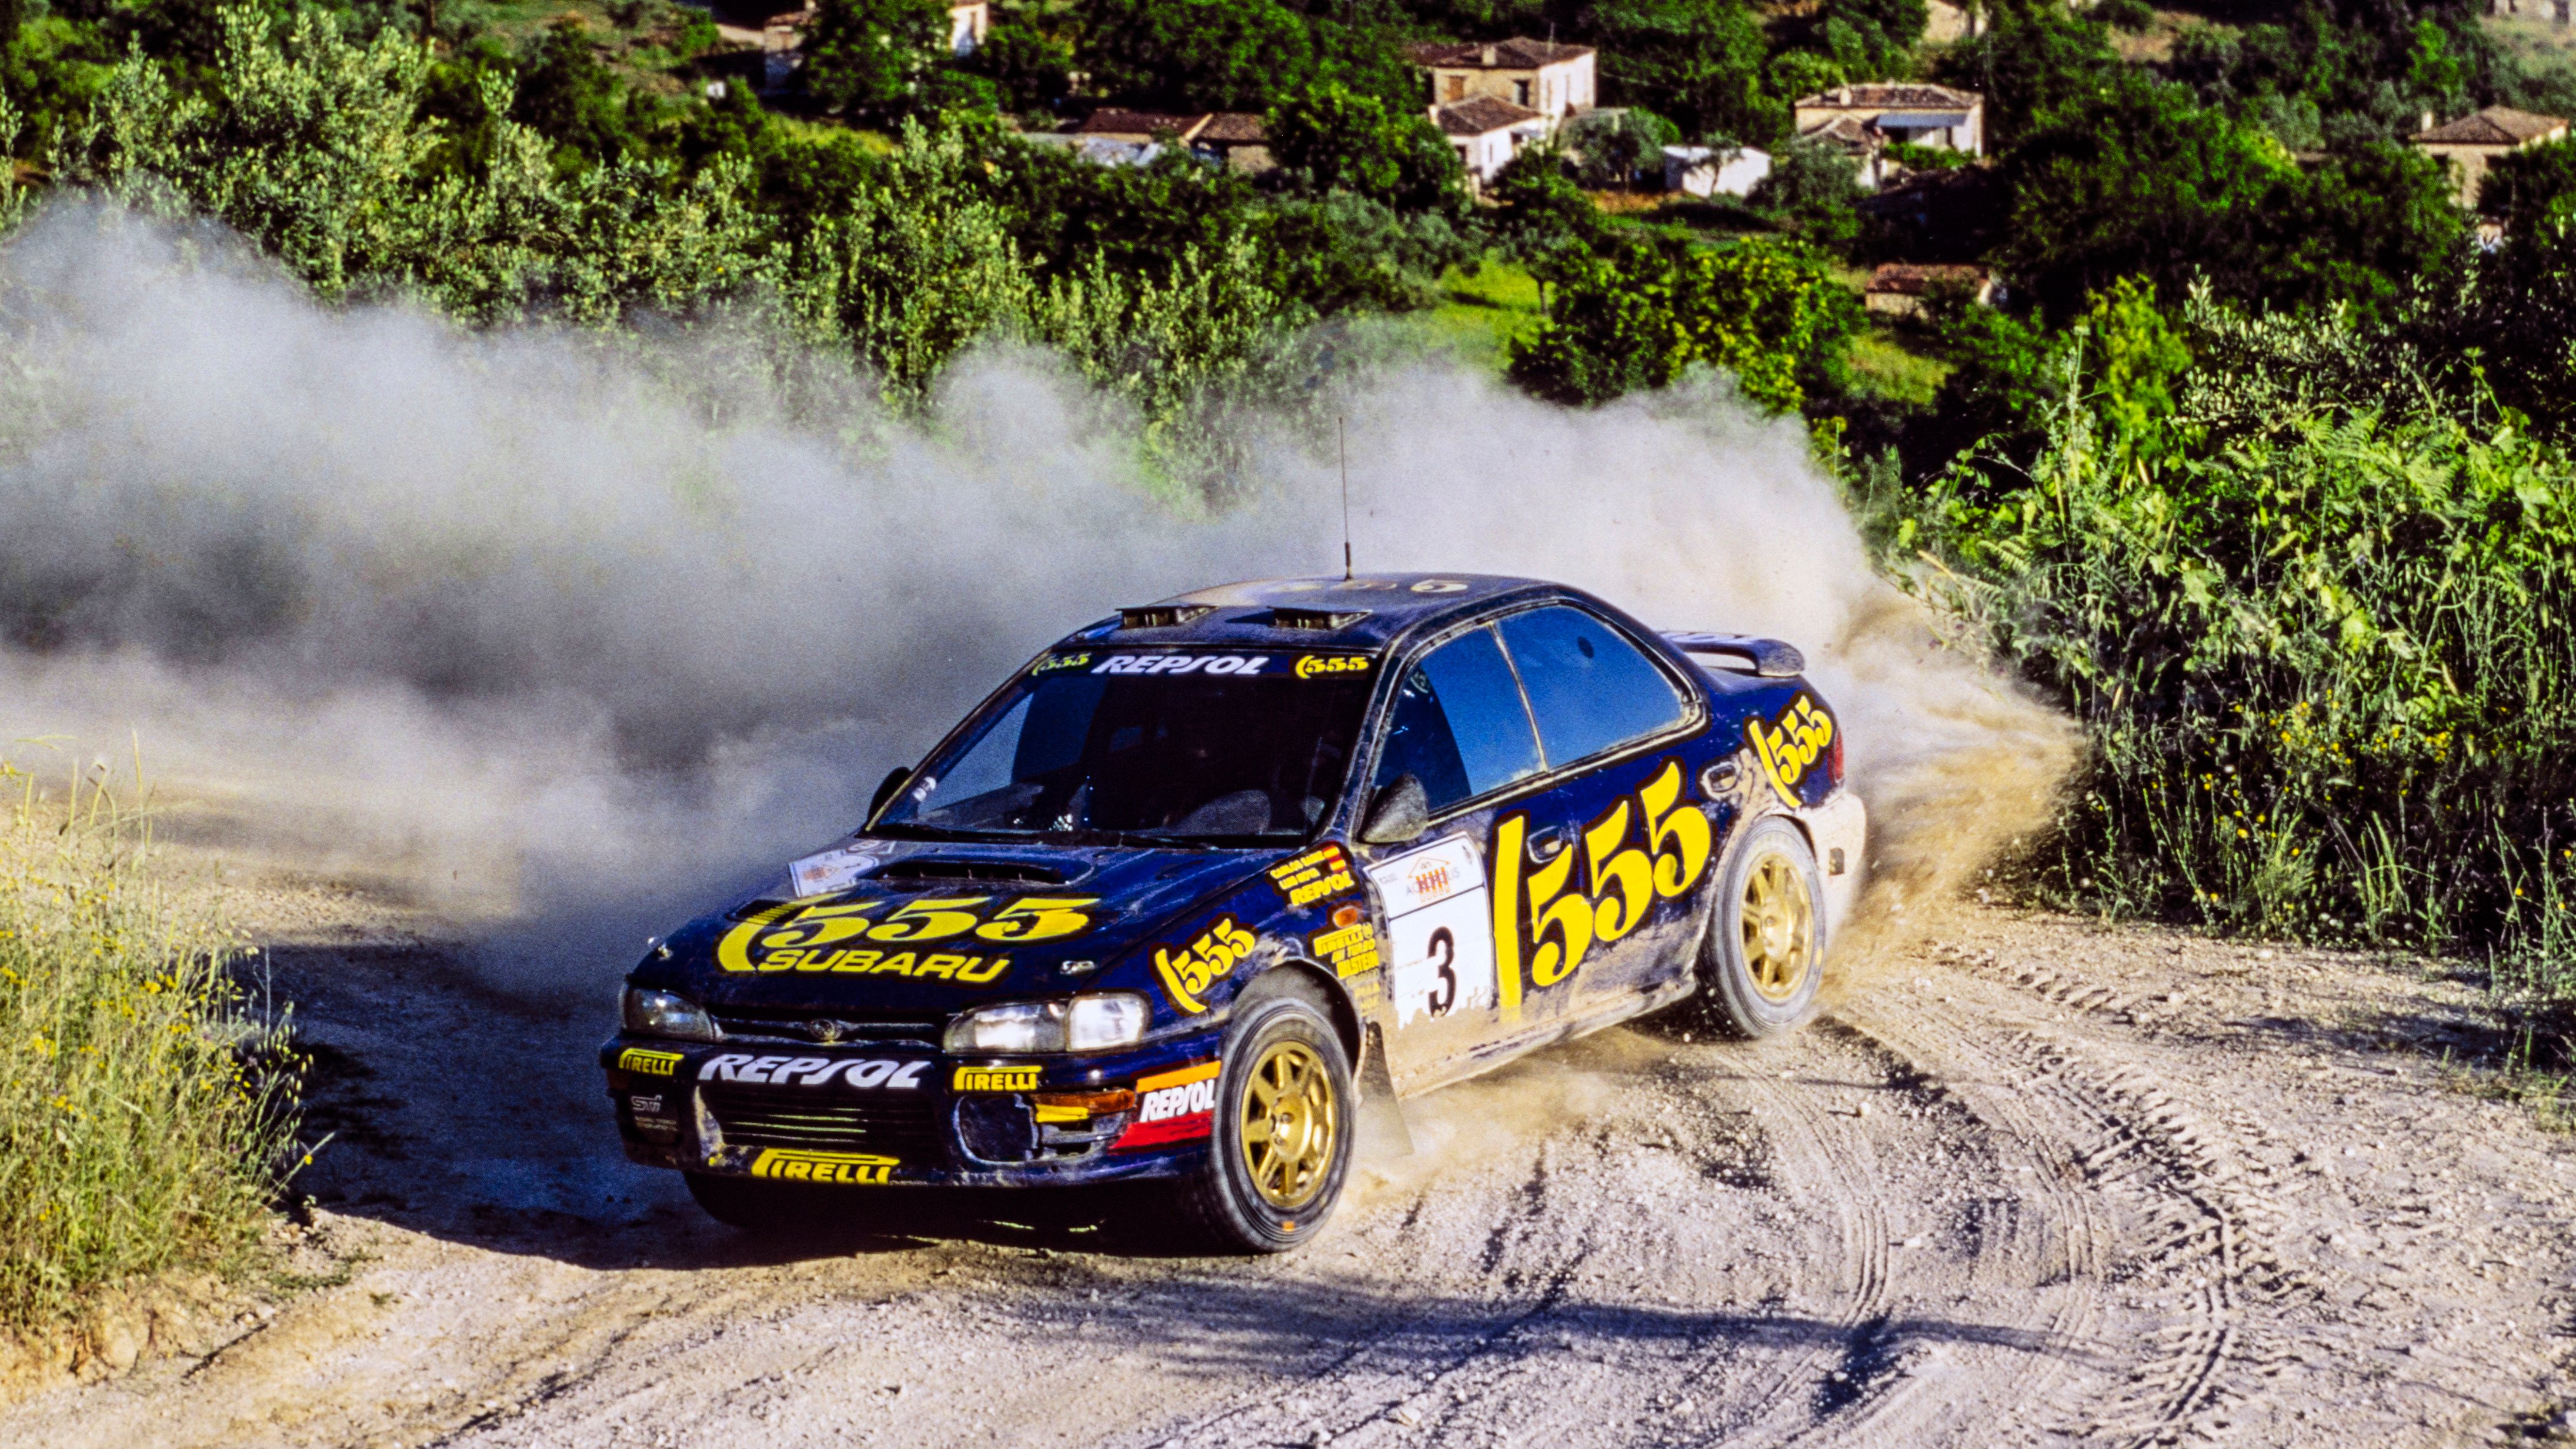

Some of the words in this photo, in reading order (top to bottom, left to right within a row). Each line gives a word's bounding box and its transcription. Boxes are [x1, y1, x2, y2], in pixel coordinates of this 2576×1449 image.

[1039, 652, 1092, 671] 555
[1091, 655, 1269, 675] REPSOL
[1307, 655, 1369, 674] 555
[1766, 695, 1833, 785] 555
[1290, 870, 1354, 906] REPSOL
[1527, 762, 1711, 987] 555
[762, 896, 1100, 949] 555
[757, 949, 1009, 983] SUBARU
[1171, 918, 1256, 994] 555
[1427, 926, 1457, 1017] 3
[619, 1048, 684, 1076] PIRELLI
[698, 1053, 932, 1089] REPSOL
[953, 1065, 1043, 1091] PIRELLI
[1139, 1078, 1214, 1123] REPSOL
[750, 1147, 901, 1185] PIRELLI
